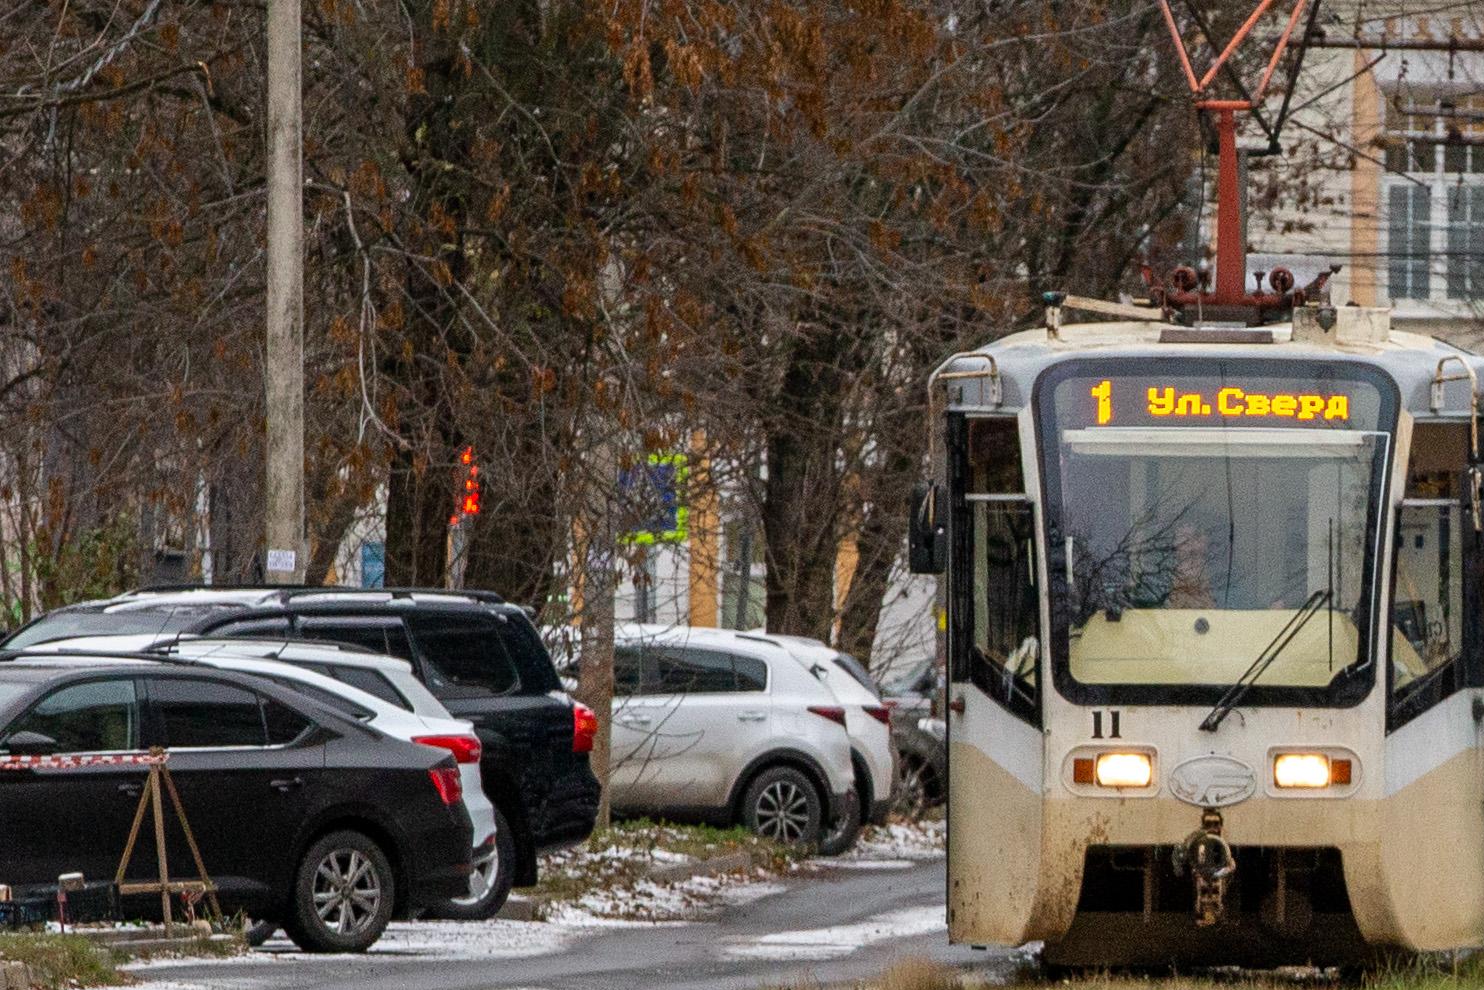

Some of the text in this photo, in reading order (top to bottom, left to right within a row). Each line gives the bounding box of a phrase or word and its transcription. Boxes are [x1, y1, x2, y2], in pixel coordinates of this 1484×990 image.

[1090, 379, 1350, 426] 1 Ул. Сверд
[1091, 709, 1122, 739] 11
